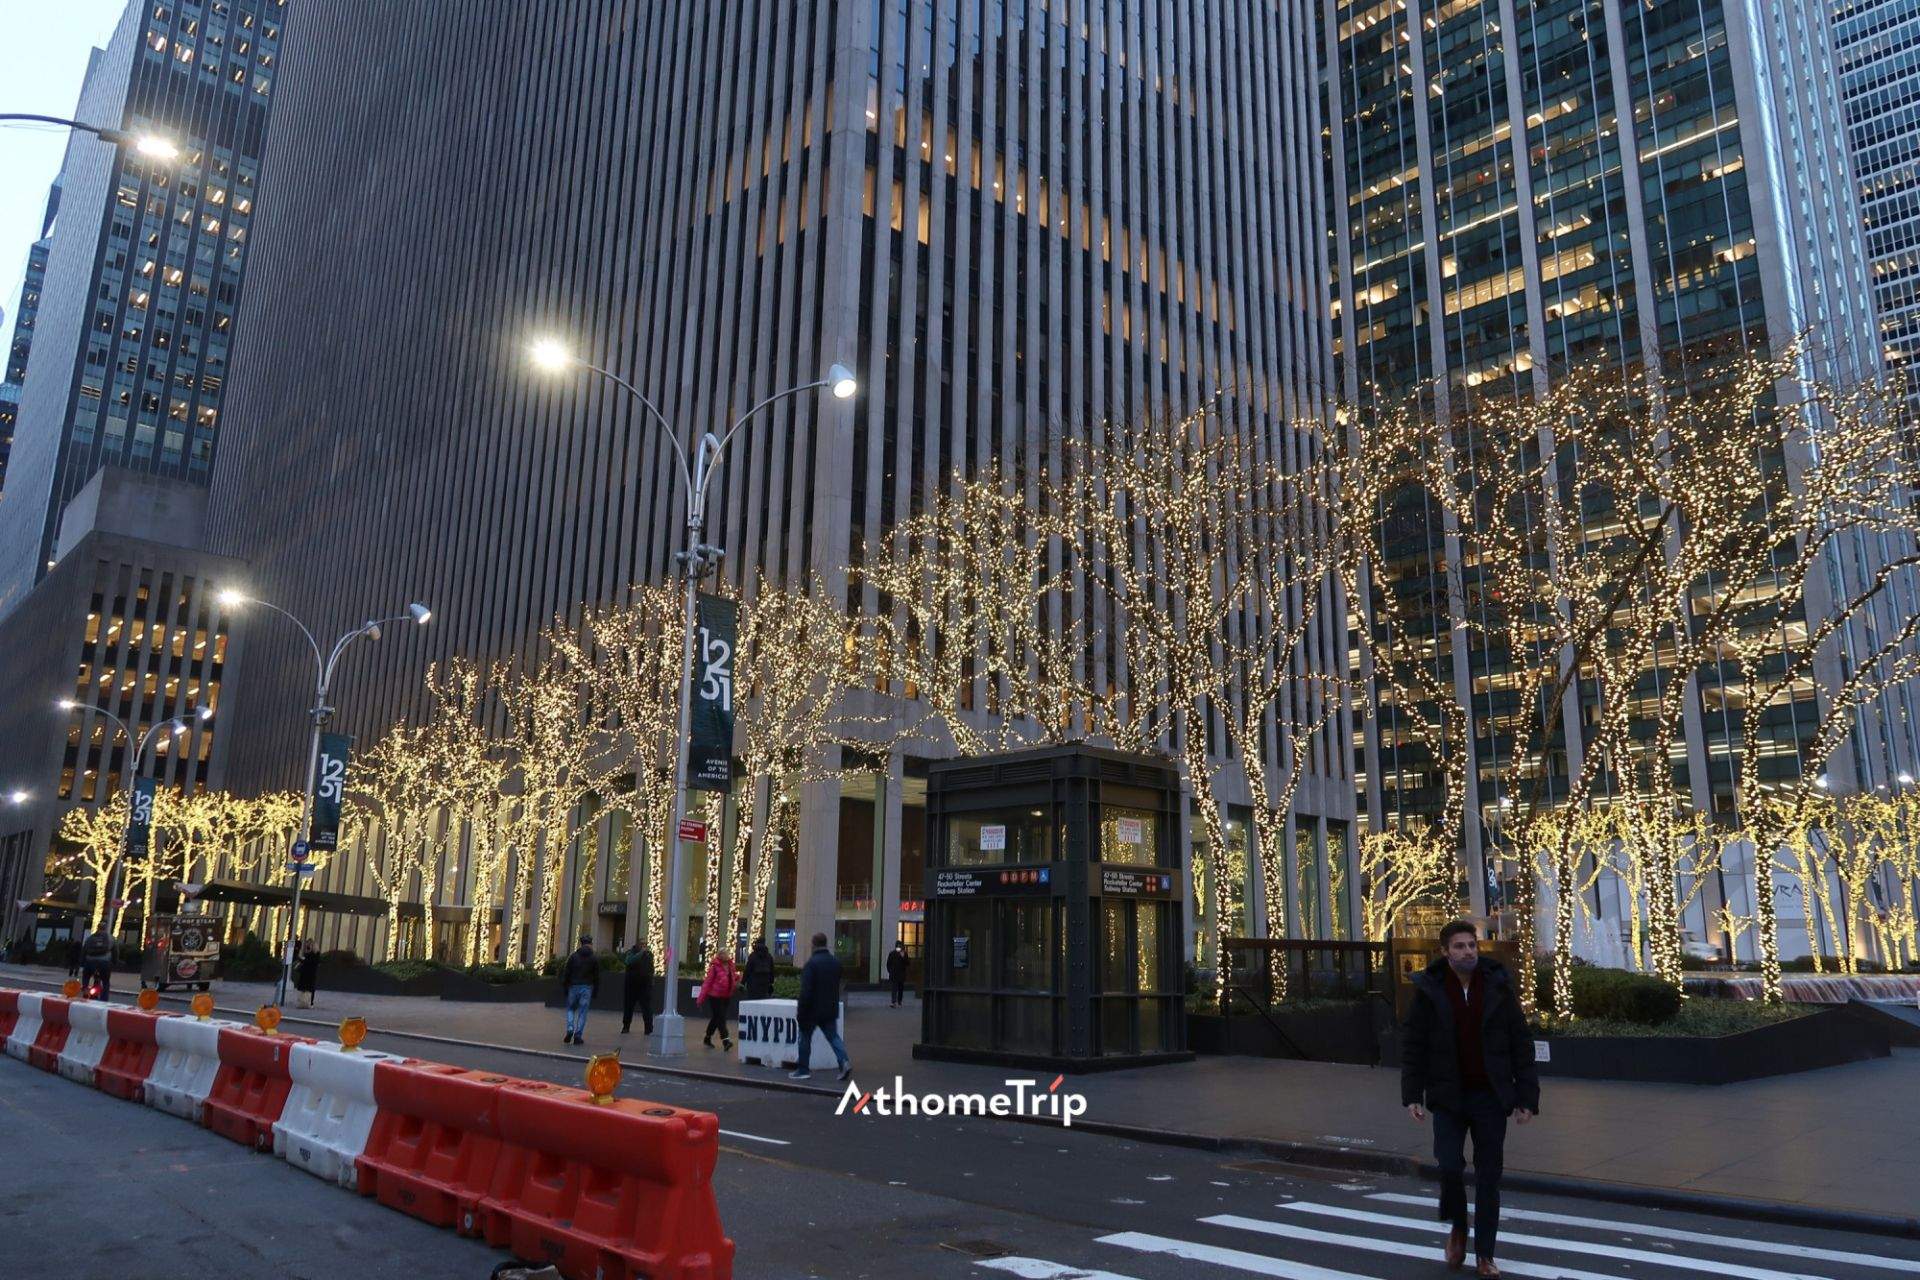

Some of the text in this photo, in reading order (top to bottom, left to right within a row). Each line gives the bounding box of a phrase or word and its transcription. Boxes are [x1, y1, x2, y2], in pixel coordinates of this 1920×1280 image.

[937, 886, 976, 896] Subway Station
[746, 1014, 799, 1045] NYPD
